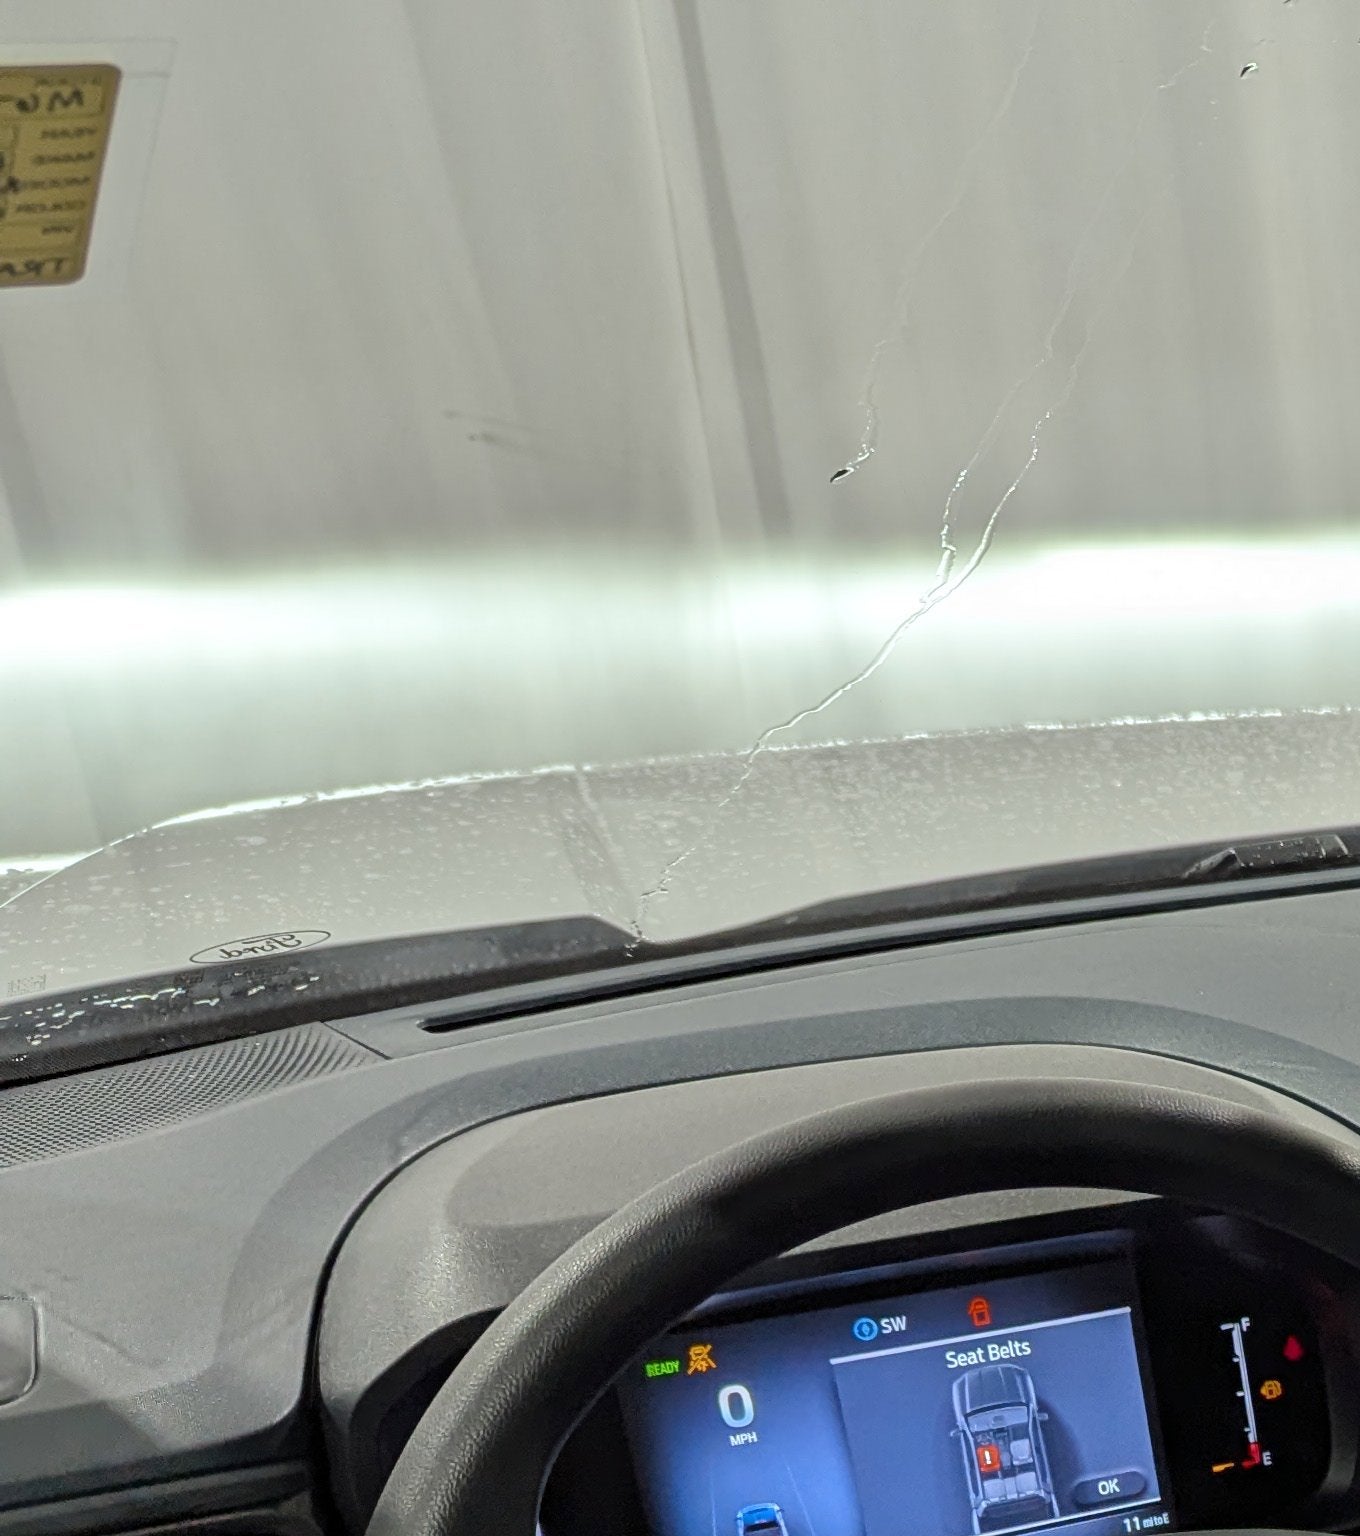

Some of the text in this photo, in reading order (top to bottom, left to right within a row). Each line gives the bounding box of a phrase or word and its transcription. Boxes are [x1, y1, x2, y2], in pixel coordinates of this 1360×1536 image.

[881, 1316, 907, 1334] SW
[945, 1339, 1032, 1369] Seat Belts
[645, 1360, 680, 1378] READY
[718, 1384, 755, 1428] 0
[729, 1431, 758, 1447] MPH
[1262, 1451, 1273, 1466] E
[1098, 1477, 1120, 1495] OK
[1123, 1516, 1141, 1533] 11
